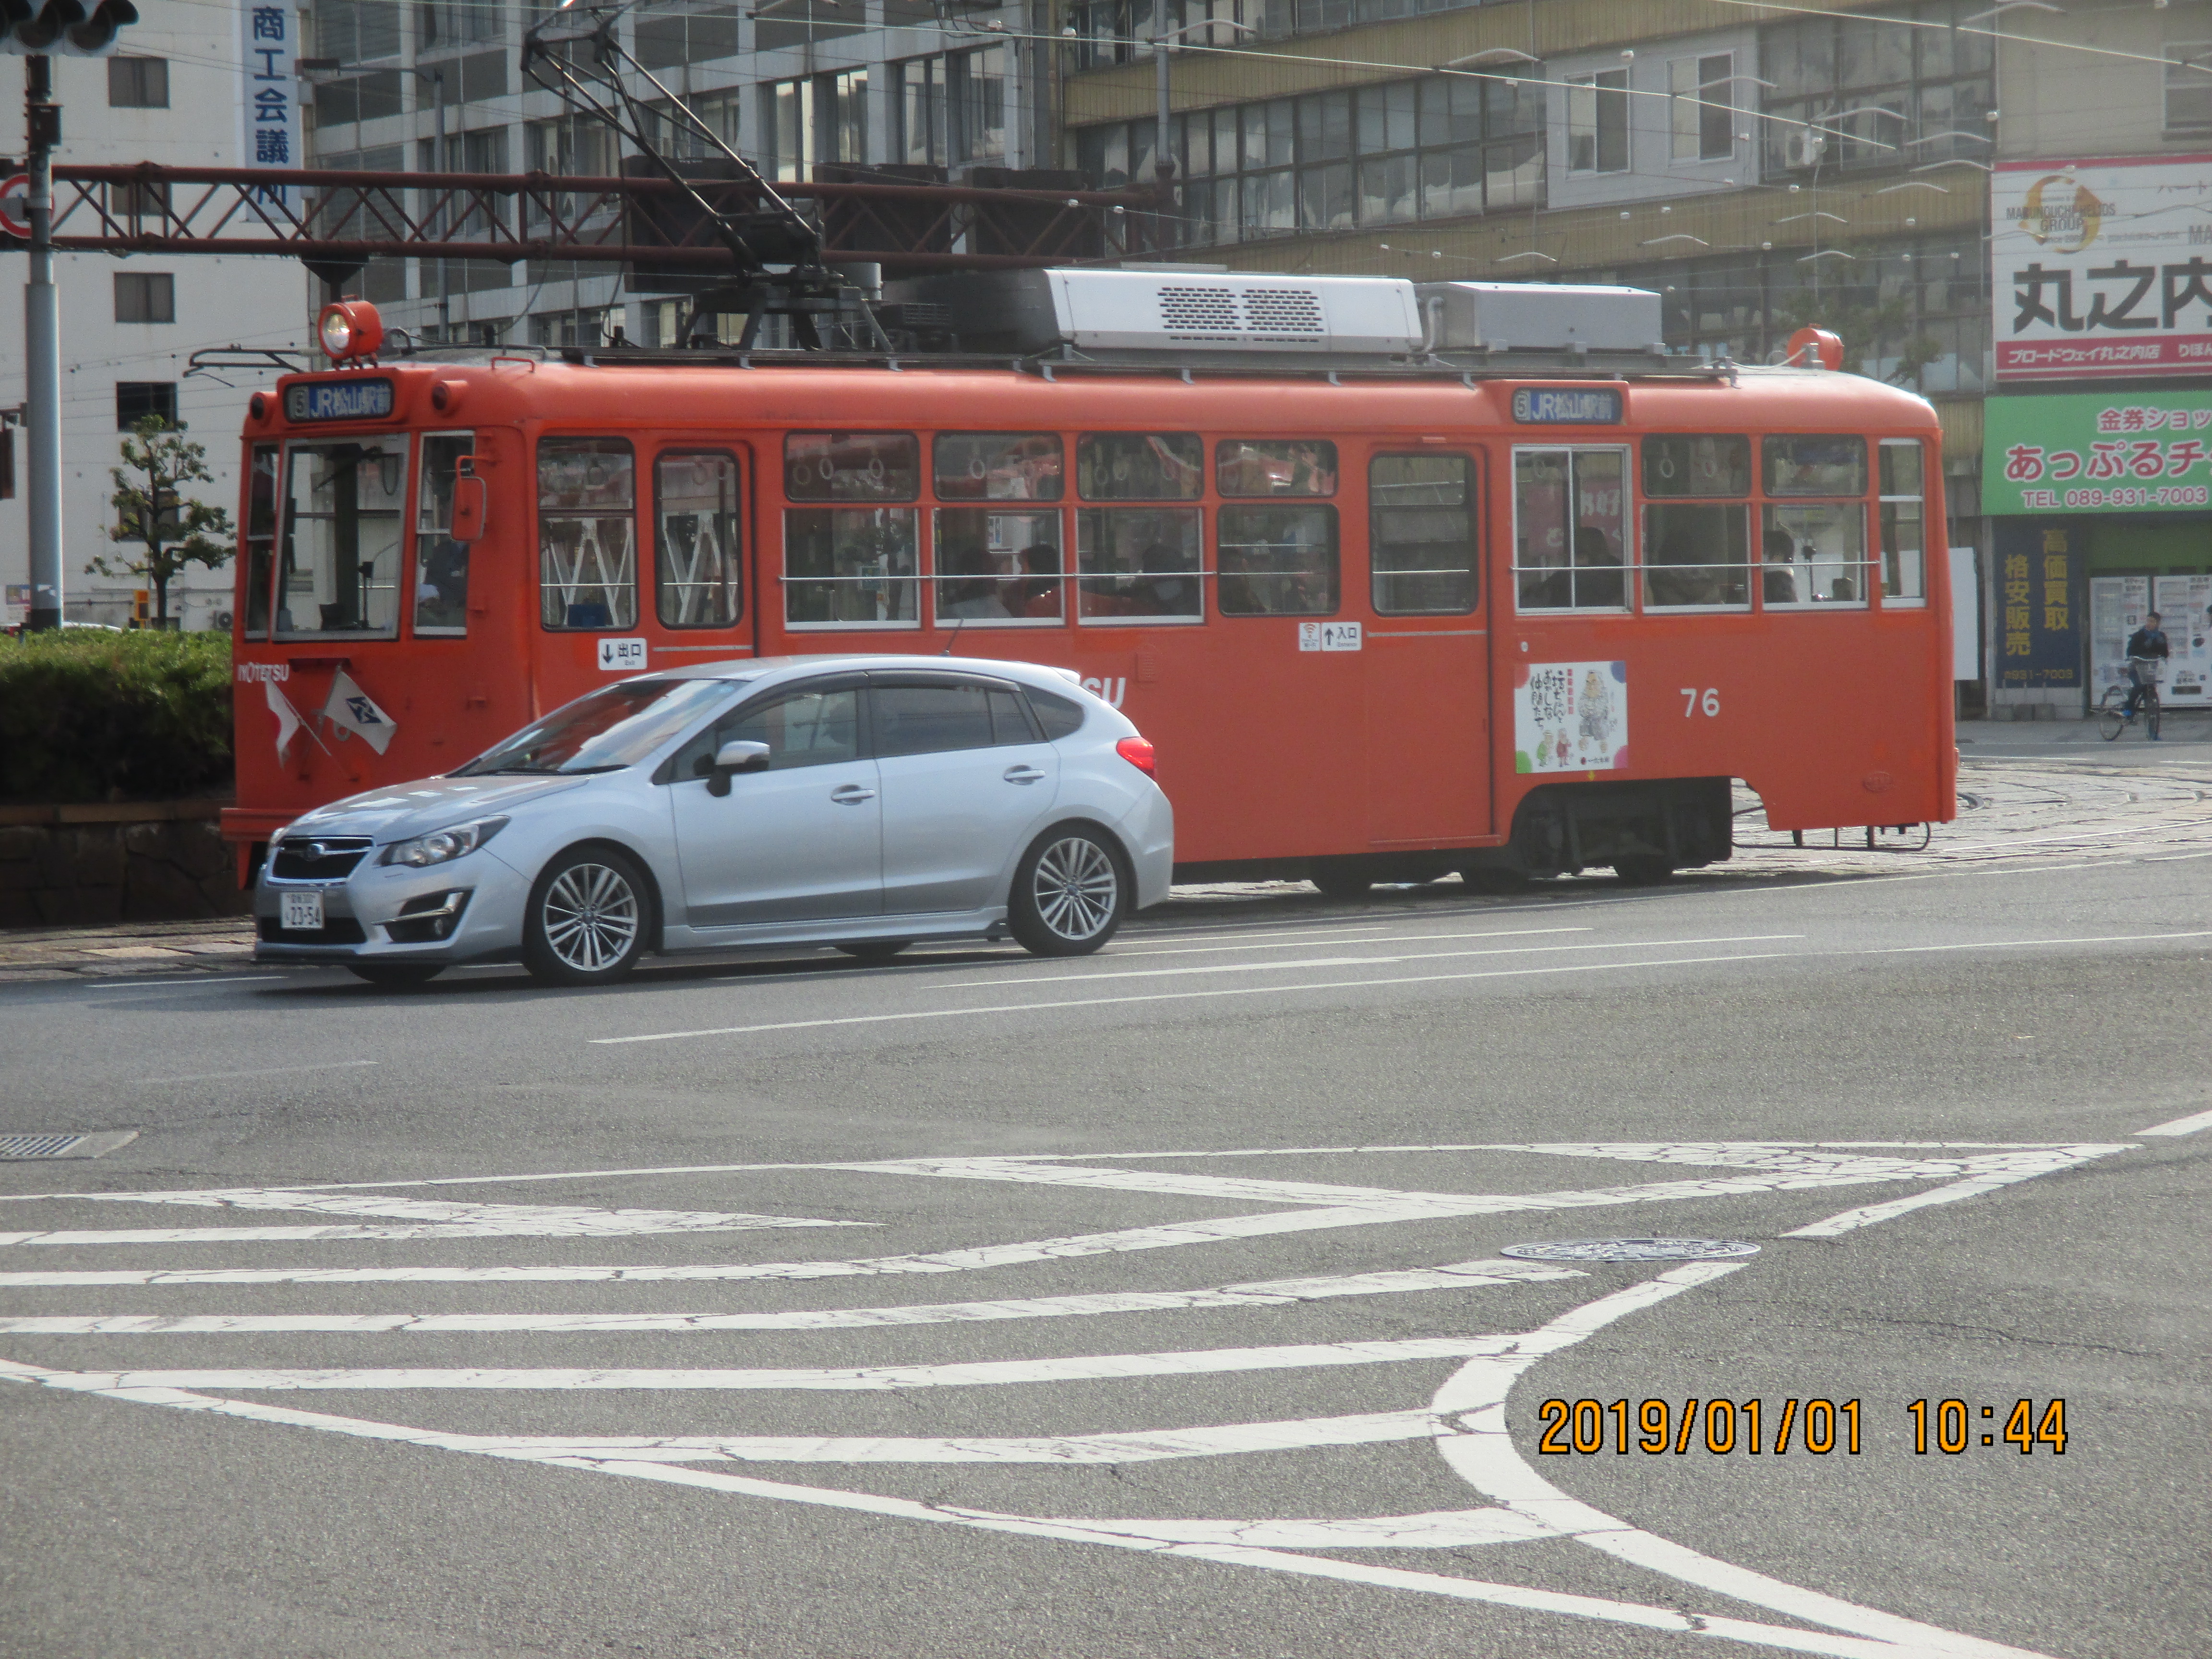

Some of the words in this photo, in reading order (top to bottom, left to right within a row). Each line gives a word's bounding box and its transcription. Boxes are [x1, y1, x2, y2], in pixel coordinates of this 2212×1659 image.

[2040, 218, 2084, 232] GROUP
[2014, 257, 2212, 334] 丸之内
[2006, 439, 2212, 481] あっぷるチ
[2023, 490, 2060, 508] TEL
[2065, 486, 2207, 507] 089-931-7003
[2043, 529, 2069, 631] 高価買取
[2005, 554, 2031, 657] 格安販売
[1337, 627, 1358, 639] 入口
[618, 642, 641, 658] 出口
[1680, 687, 1720, 718] 76
